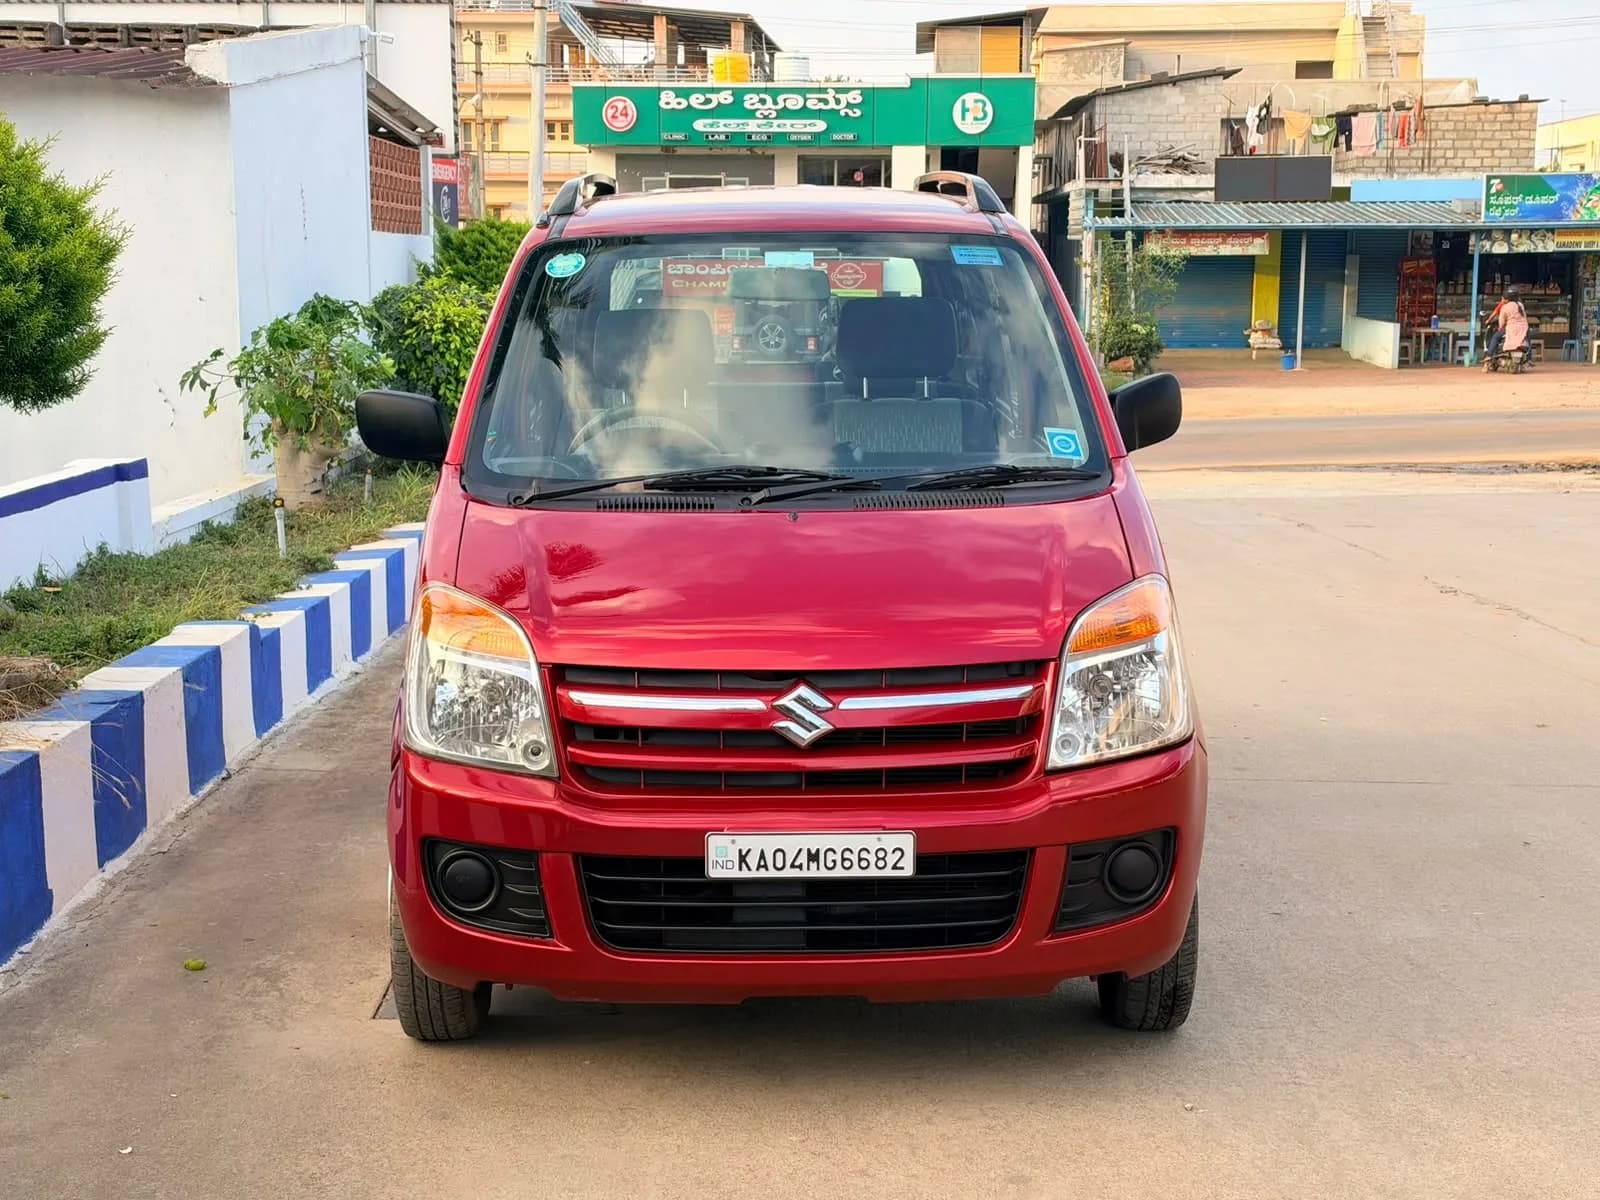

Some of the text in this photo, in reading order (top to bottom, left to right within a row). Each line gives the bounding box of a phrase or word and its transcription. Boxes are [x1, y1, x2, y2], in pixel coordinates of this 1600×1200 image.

[658, 90, 734, 109] ಹಿಲ್
[610, 104, 629, 119] 24
[712, 847, 905, 872] IND KA04MG6682
